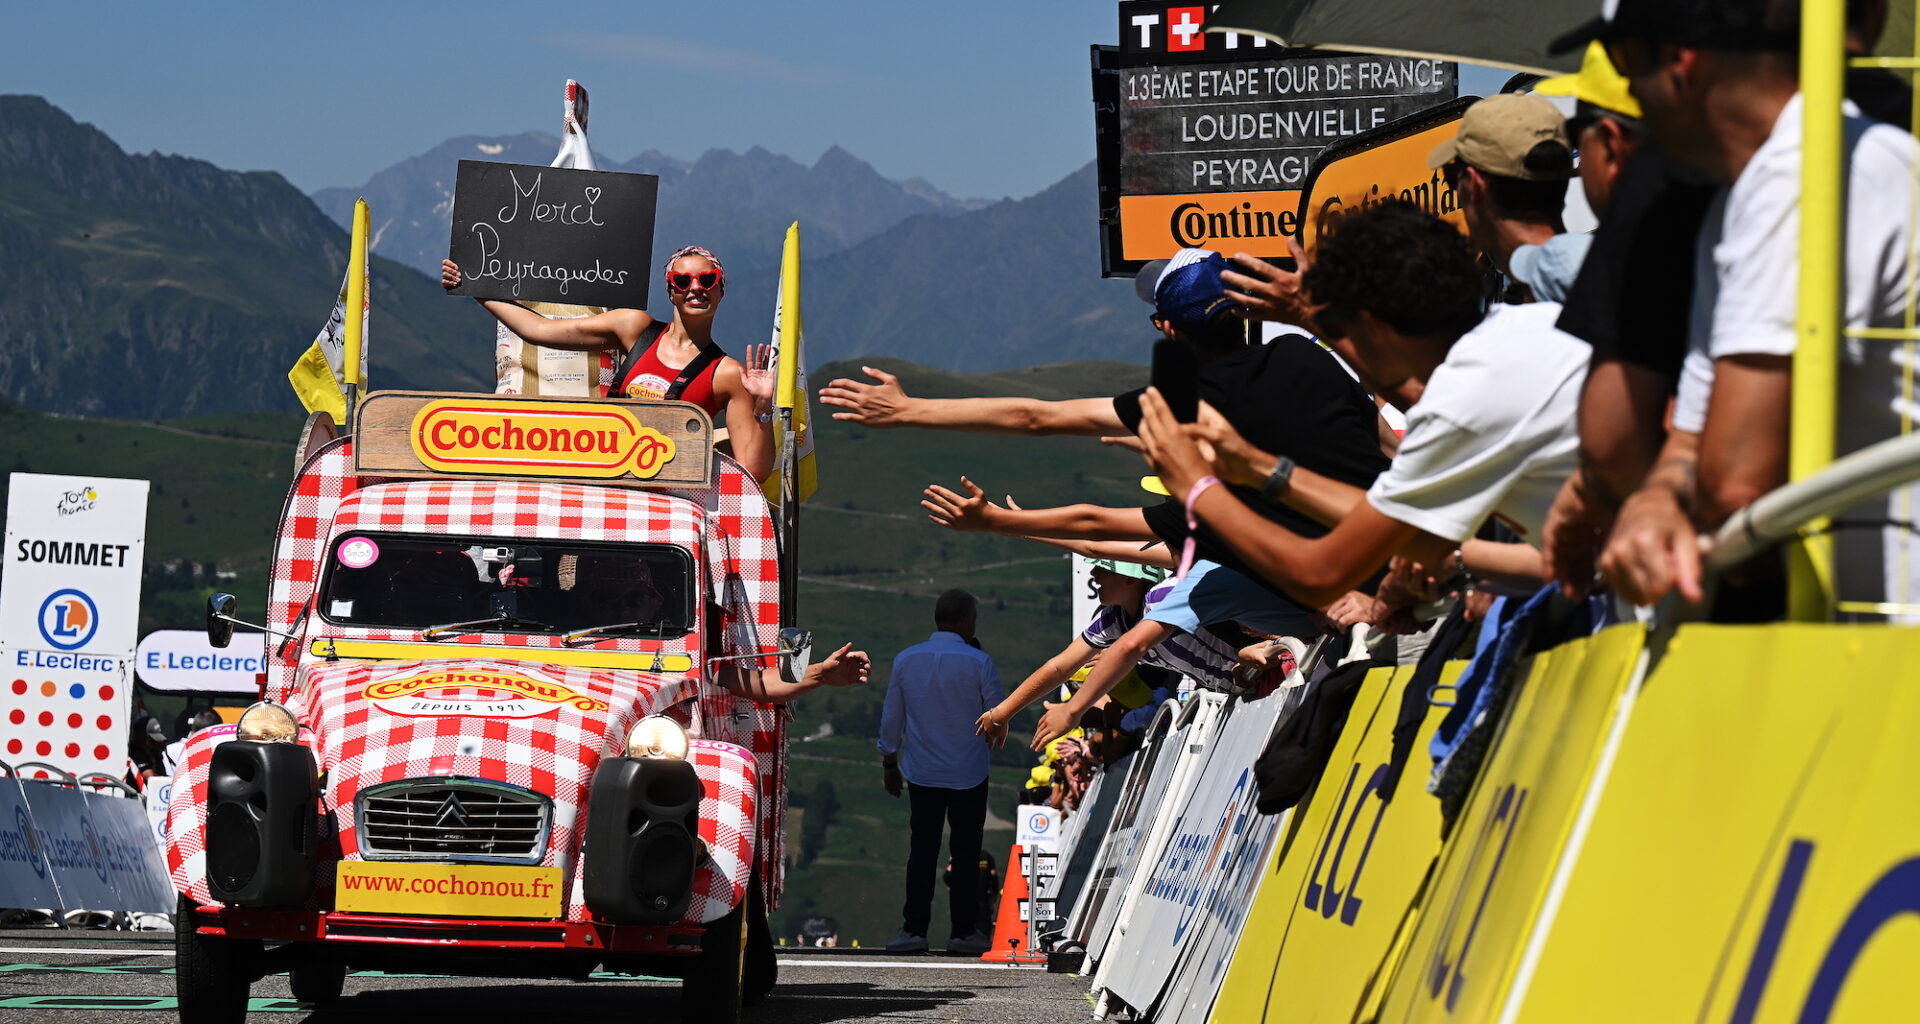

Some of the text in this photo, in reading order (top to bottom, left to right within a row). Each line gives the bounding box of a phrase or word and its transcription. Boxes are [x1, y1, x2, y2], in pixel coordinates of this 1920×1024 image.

[1128, 60, 1444, 101] 13ÈME ETAPE TOUR DE FRANCE
[1181, 107, 1386, 143] LOUDENVIELLE
[498, 169, 604, 225] Merci
[1170, 201, 1297, 249] Contine
[465, 222, 629, 296] Peyragudes
[431, 418, 619, 454] Cochonou
[17, 539, 130, 567] SOMMET
[16, 650, 113, 672] E.Leclerc
[146, 652, 257, 672] E.Leclerc
[376, 673, 560, 698] Cochonou
[410, 703, 526, 712] DEPUIS 1971
[342, 874, 554, 898] www.cochonou.fr
